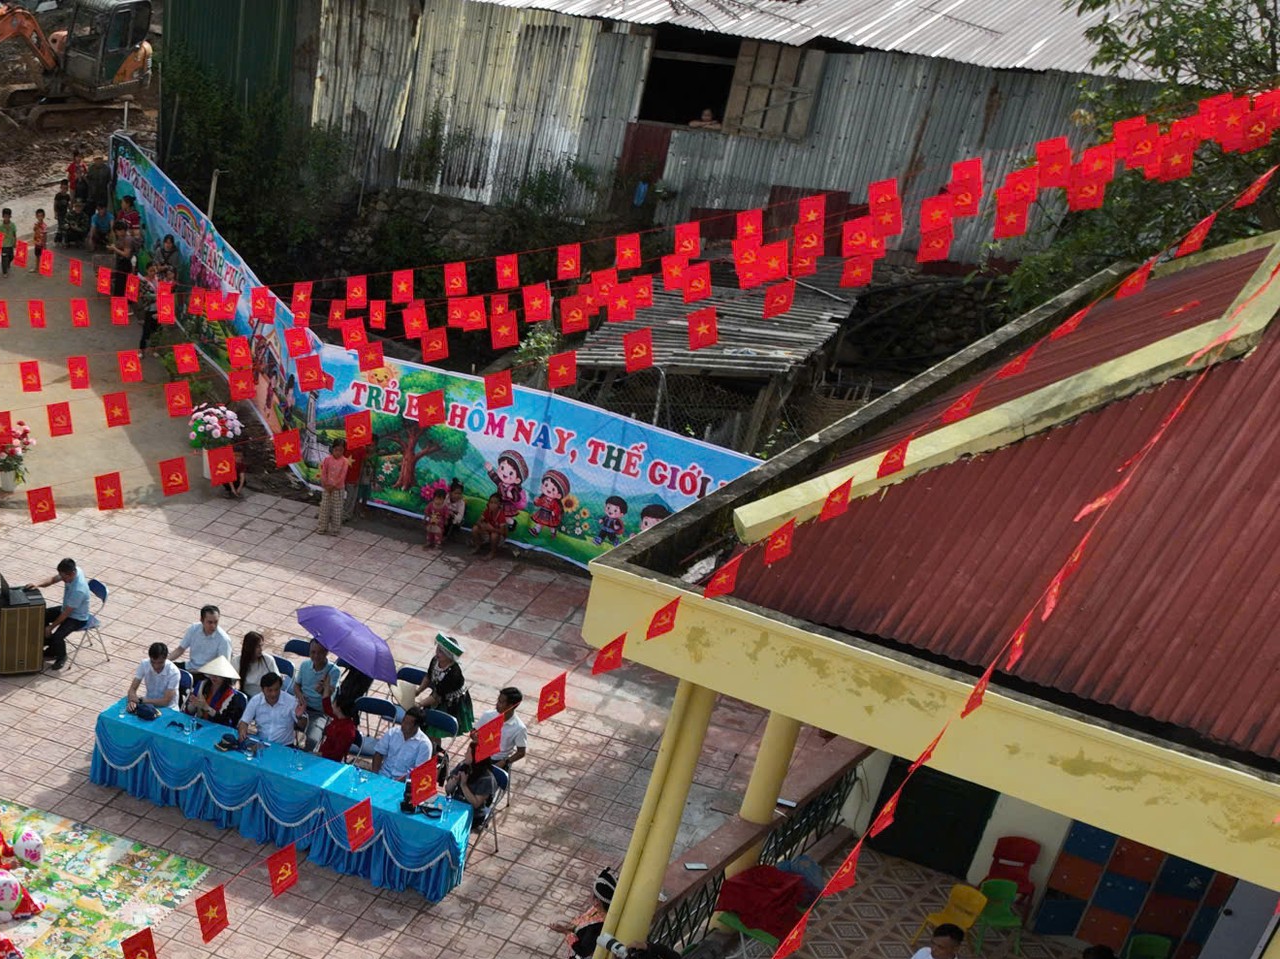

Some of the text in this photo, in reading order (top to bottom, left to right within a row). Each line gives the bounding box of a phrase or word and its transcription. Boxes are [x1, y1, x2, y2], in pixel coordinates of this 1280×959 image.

[351, 380, 400, 414] TRẺ
[447, 402, 508, 438] HÔM
[512, 418, 577, 463] NAY,
[587, 439, 645, 478] THẾ
[648, 461, 711, 499] GIỚI
